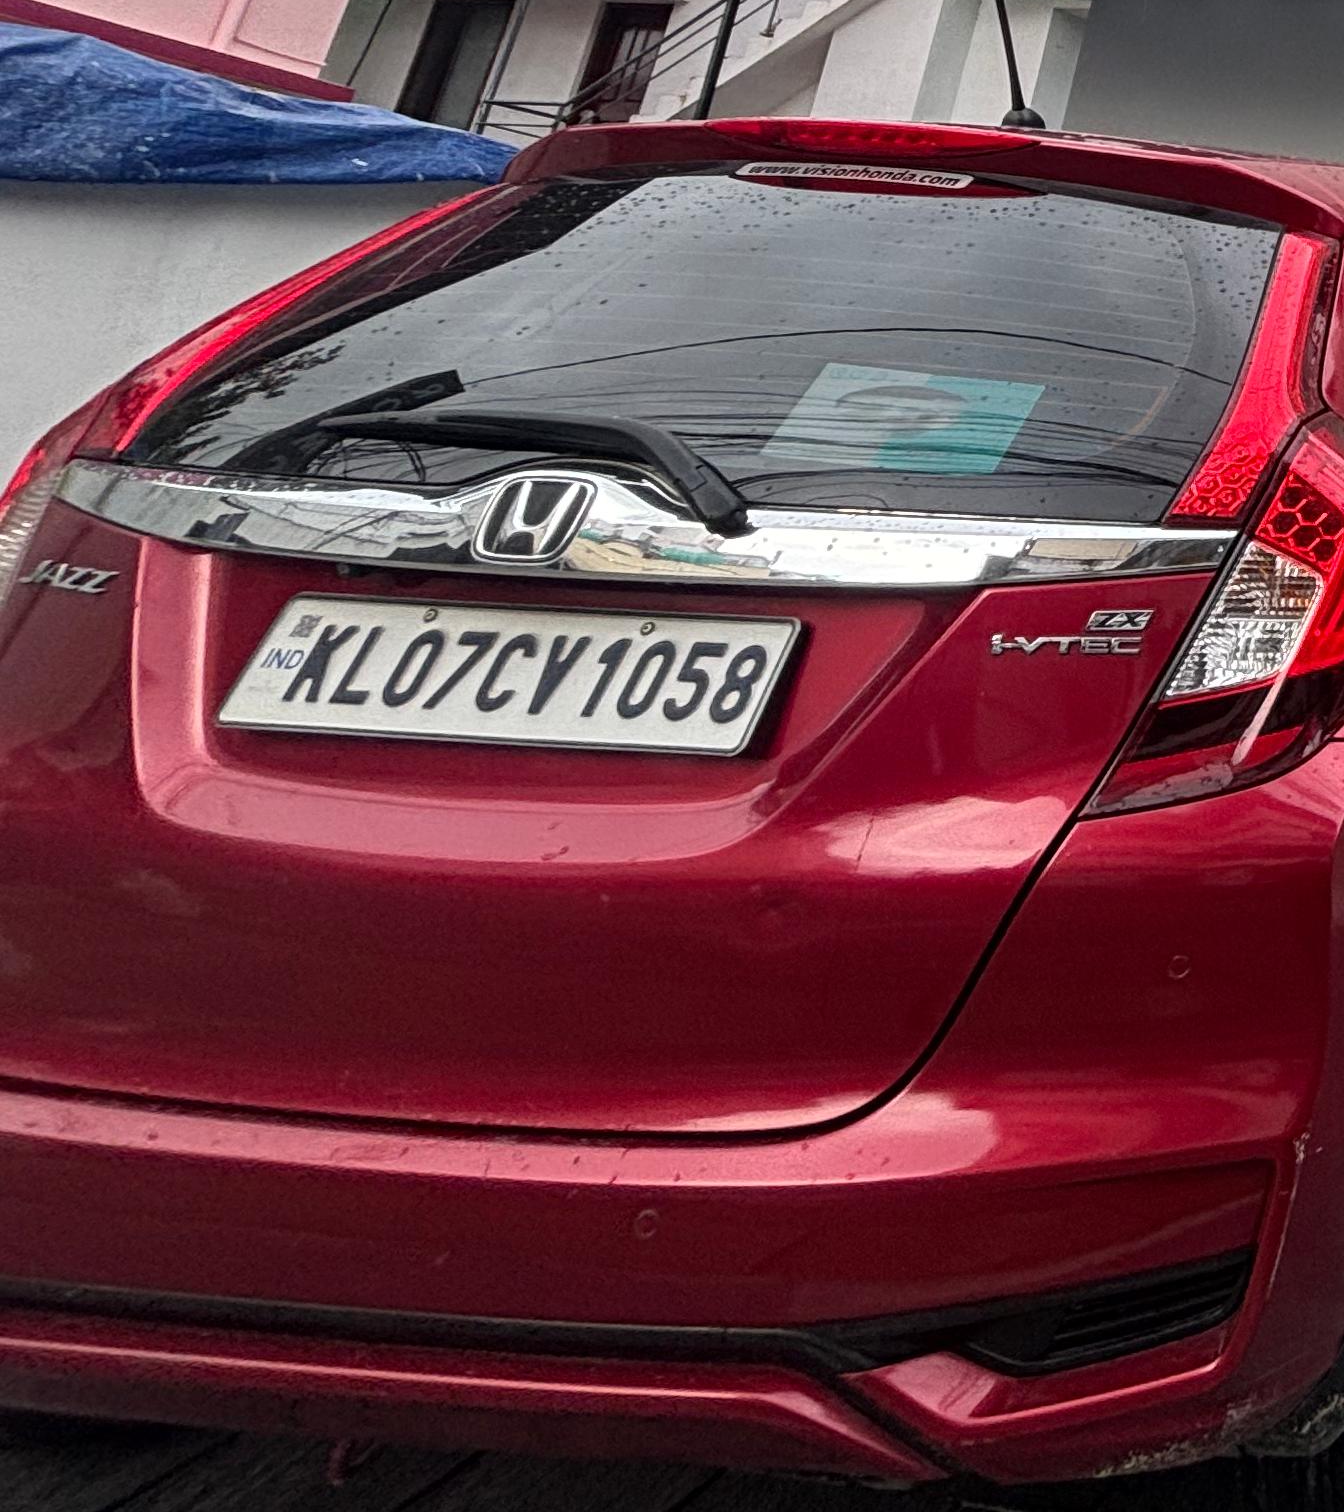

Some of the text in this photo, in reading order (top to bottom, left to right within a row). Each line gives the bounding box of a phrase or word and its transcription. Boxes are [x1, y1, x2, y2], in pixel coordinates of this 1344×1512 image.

[748, 164, 961, 187] www.visionhonda.com
[19, 559, 120, 594] JAZZ
[1091, 611, 1152, 629] ZX
[260, 648, 305, 669] IND
[283, 623, 769, 724] KL07CV1058
